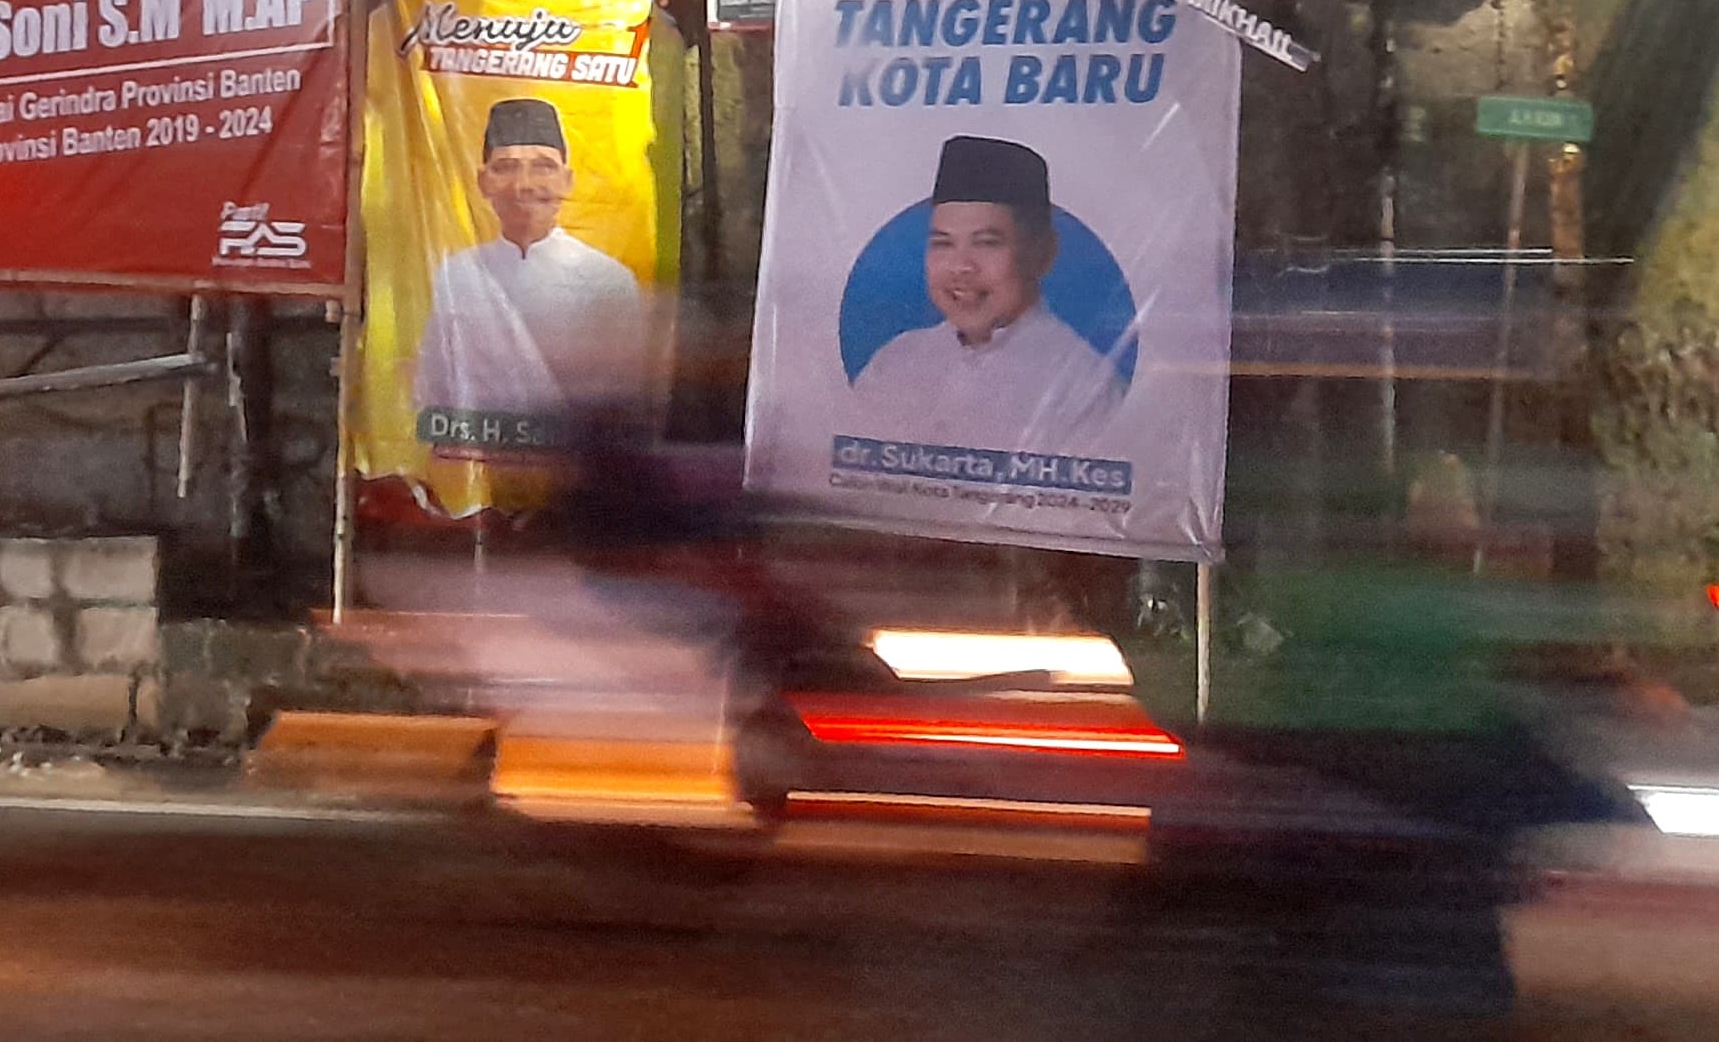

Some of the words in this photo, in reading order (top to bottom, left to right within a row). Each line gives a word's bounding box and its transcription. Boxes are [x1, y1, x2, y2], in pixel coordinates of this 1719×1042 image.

[398, 2, 581, 53] Menuju
[429, 46, 570, 83] TANGERANG
[570, 54, 638, 86] SATU
[838, 56, 983, 107] KOTA
[1003, 53, 1166, 105] BARU
[18, 82, 118, 123] Gerindra
[121, 72, 215, 109] Provinsi
[220, 66, 301, 98] Banten
[61, 122, 141, 154] Banten
[145, 115, 200, 148] 2019
[218, 105, 274, 138] 2024
[430, 413, 476, 442] Drs.
